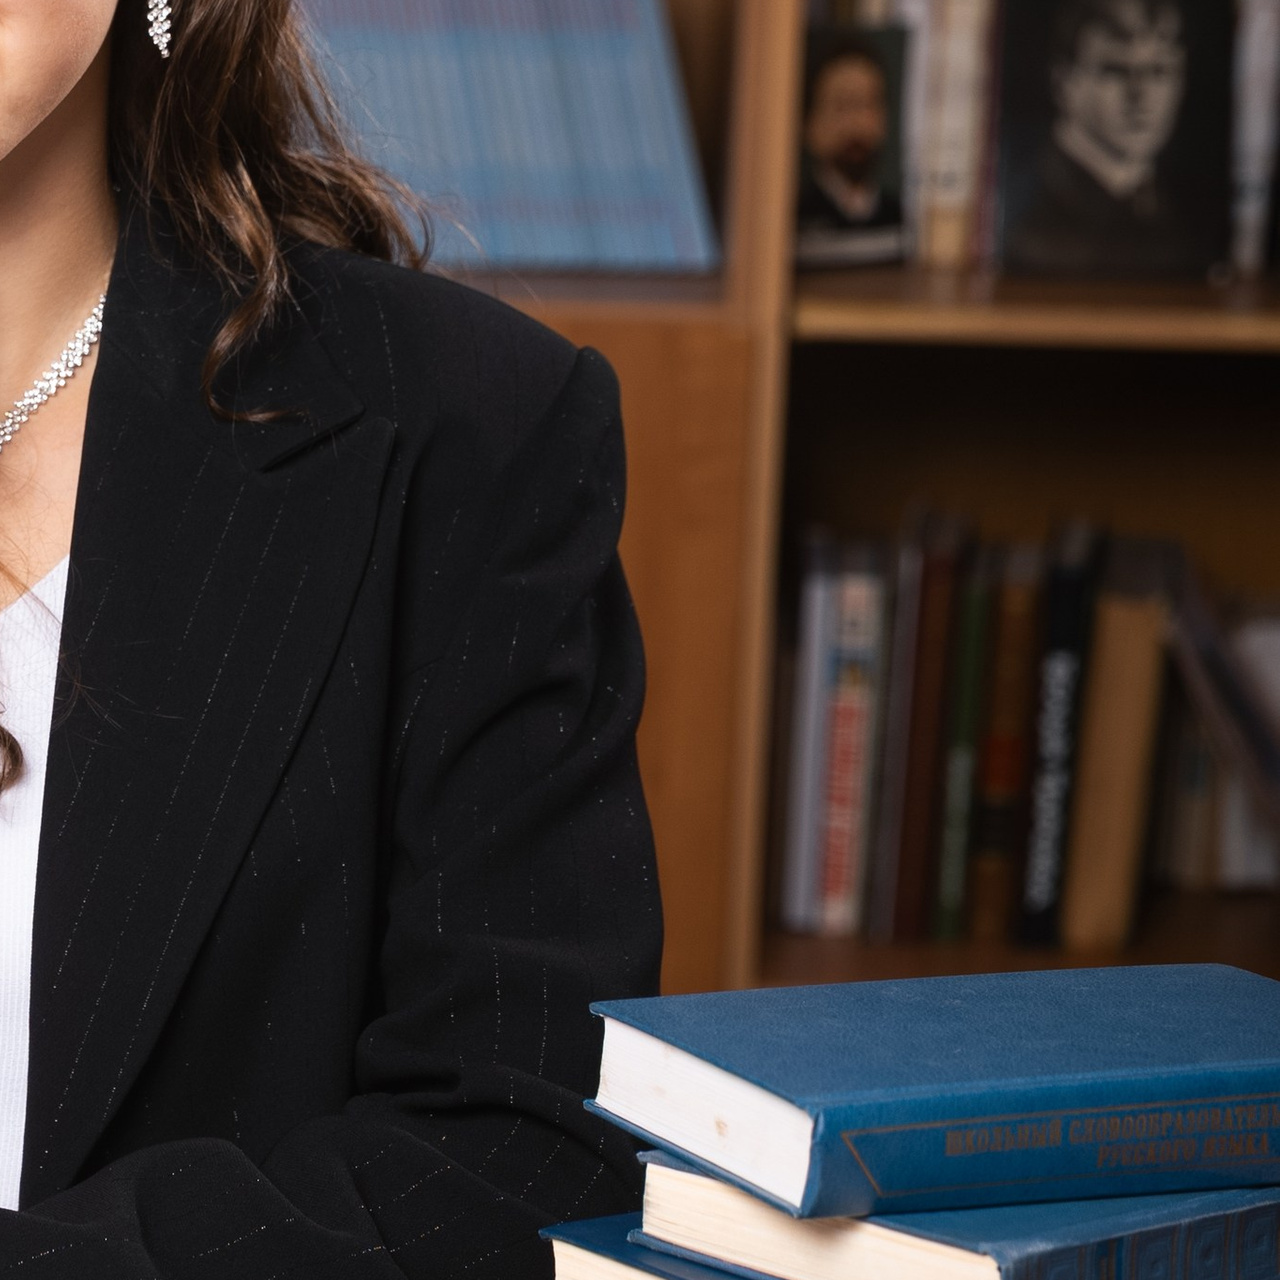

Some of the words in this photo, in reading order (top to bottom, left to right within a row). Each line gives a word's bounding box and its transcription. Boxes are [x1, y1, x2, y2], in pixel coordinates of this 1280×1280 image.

[945, 1118, 1062, 1157] ШКОЛЬНЫЙ
[1097, 1138, 1197, 1168] РУССКОГО
[1203, 1132, 1269, 1158] ЯЗЫКА
